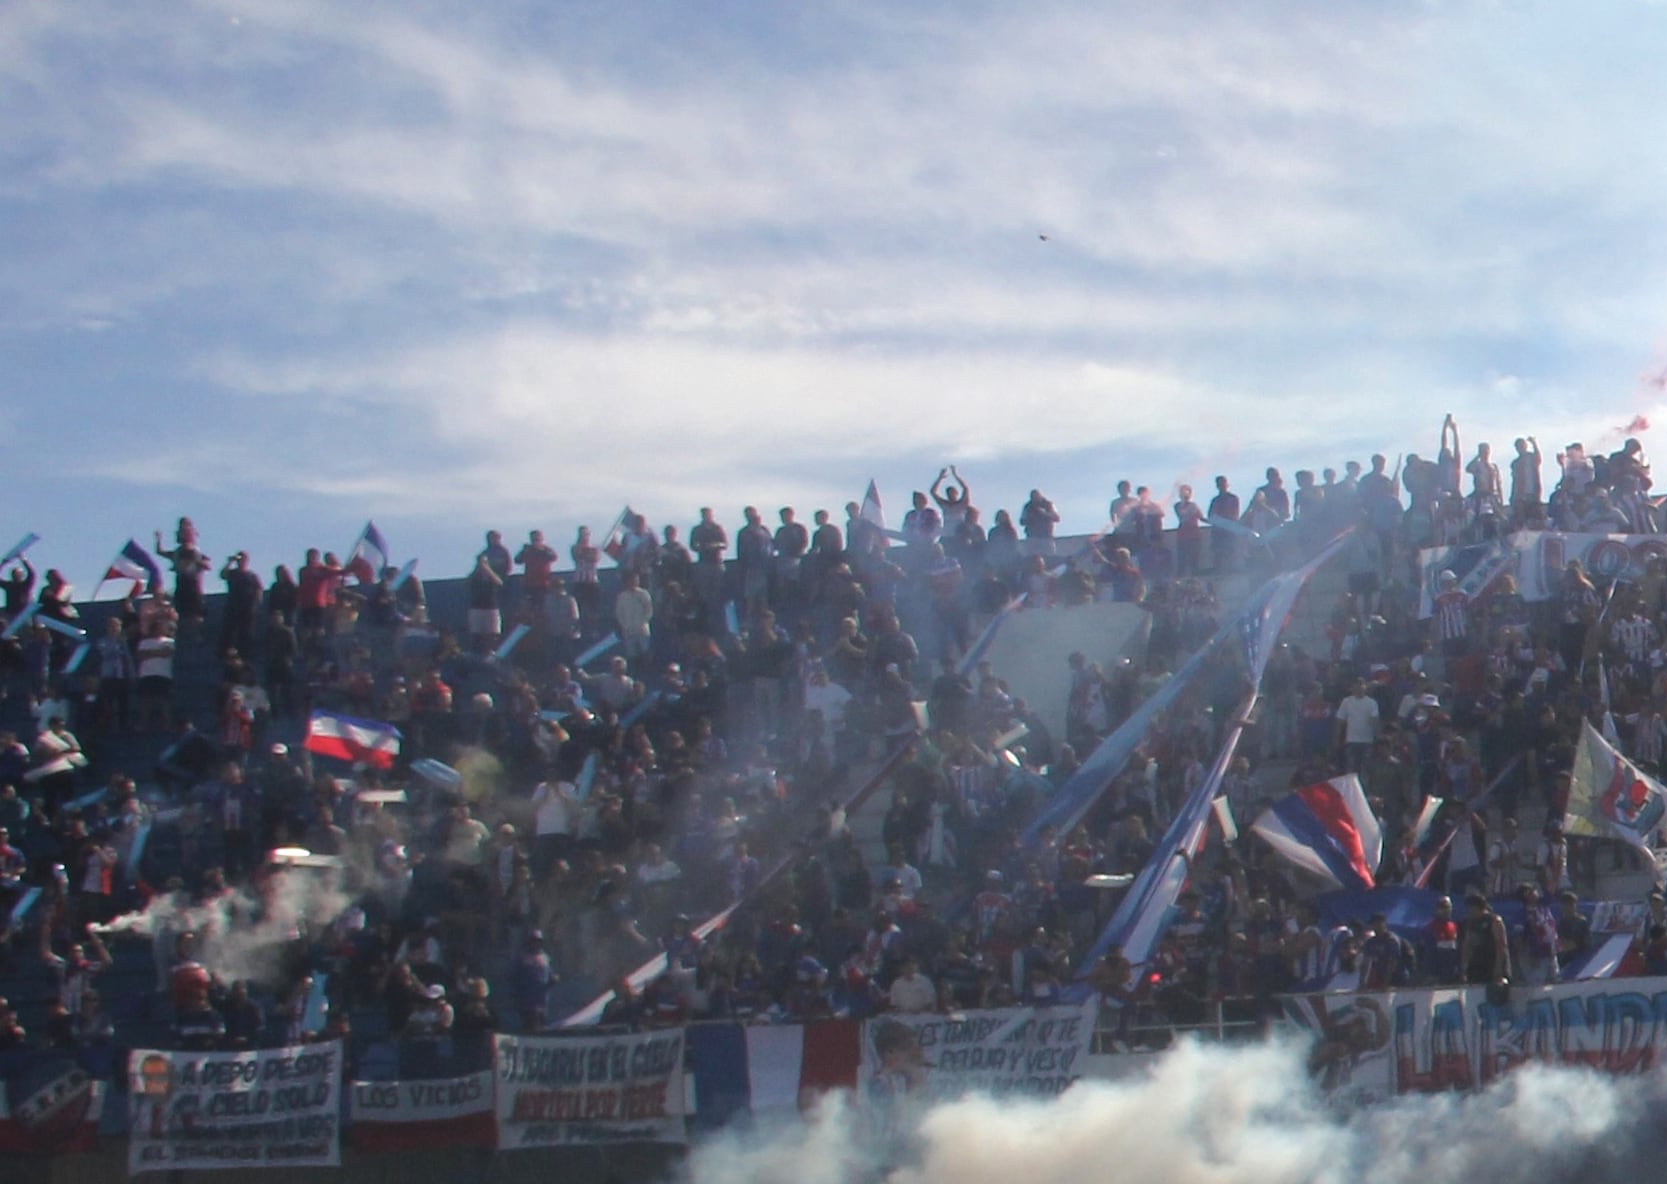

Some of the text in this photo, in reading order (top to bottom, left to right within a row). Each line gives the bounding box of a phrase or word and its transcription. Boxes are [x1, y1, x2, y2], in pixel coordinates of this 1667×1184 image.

[1393, 999, 1468, 1093] LA
[263, 1050, 336, 1082] DESDE
[272, 1082, 330, 1113] SOLO
[357, 1076, 482, 1109] LOS VICIOS
